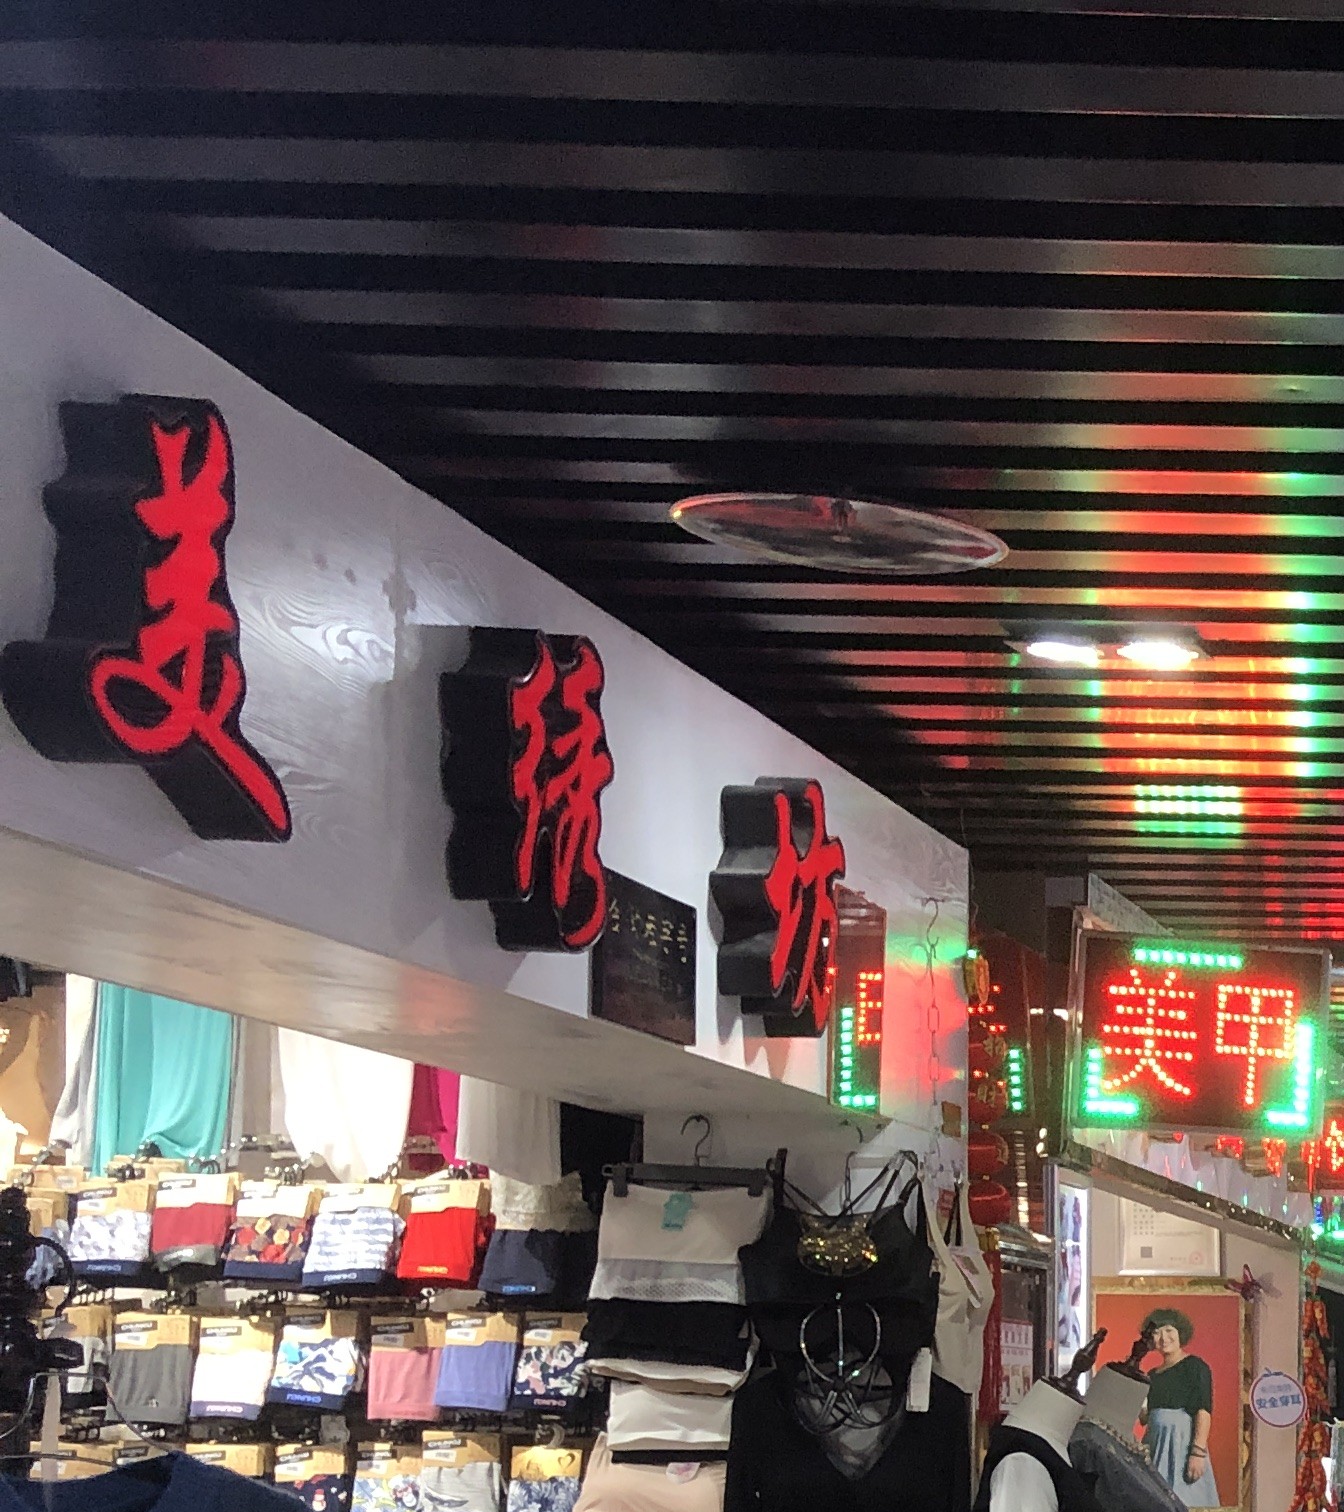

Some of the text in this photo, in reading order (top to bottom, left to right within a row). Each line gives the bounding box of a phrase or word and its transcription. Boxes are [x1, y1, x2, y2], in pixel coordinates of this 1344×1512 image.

[1100, 968, 1297, 1108] 美甲
[1256, 1394, 1302, 1409] 安全穿耳
